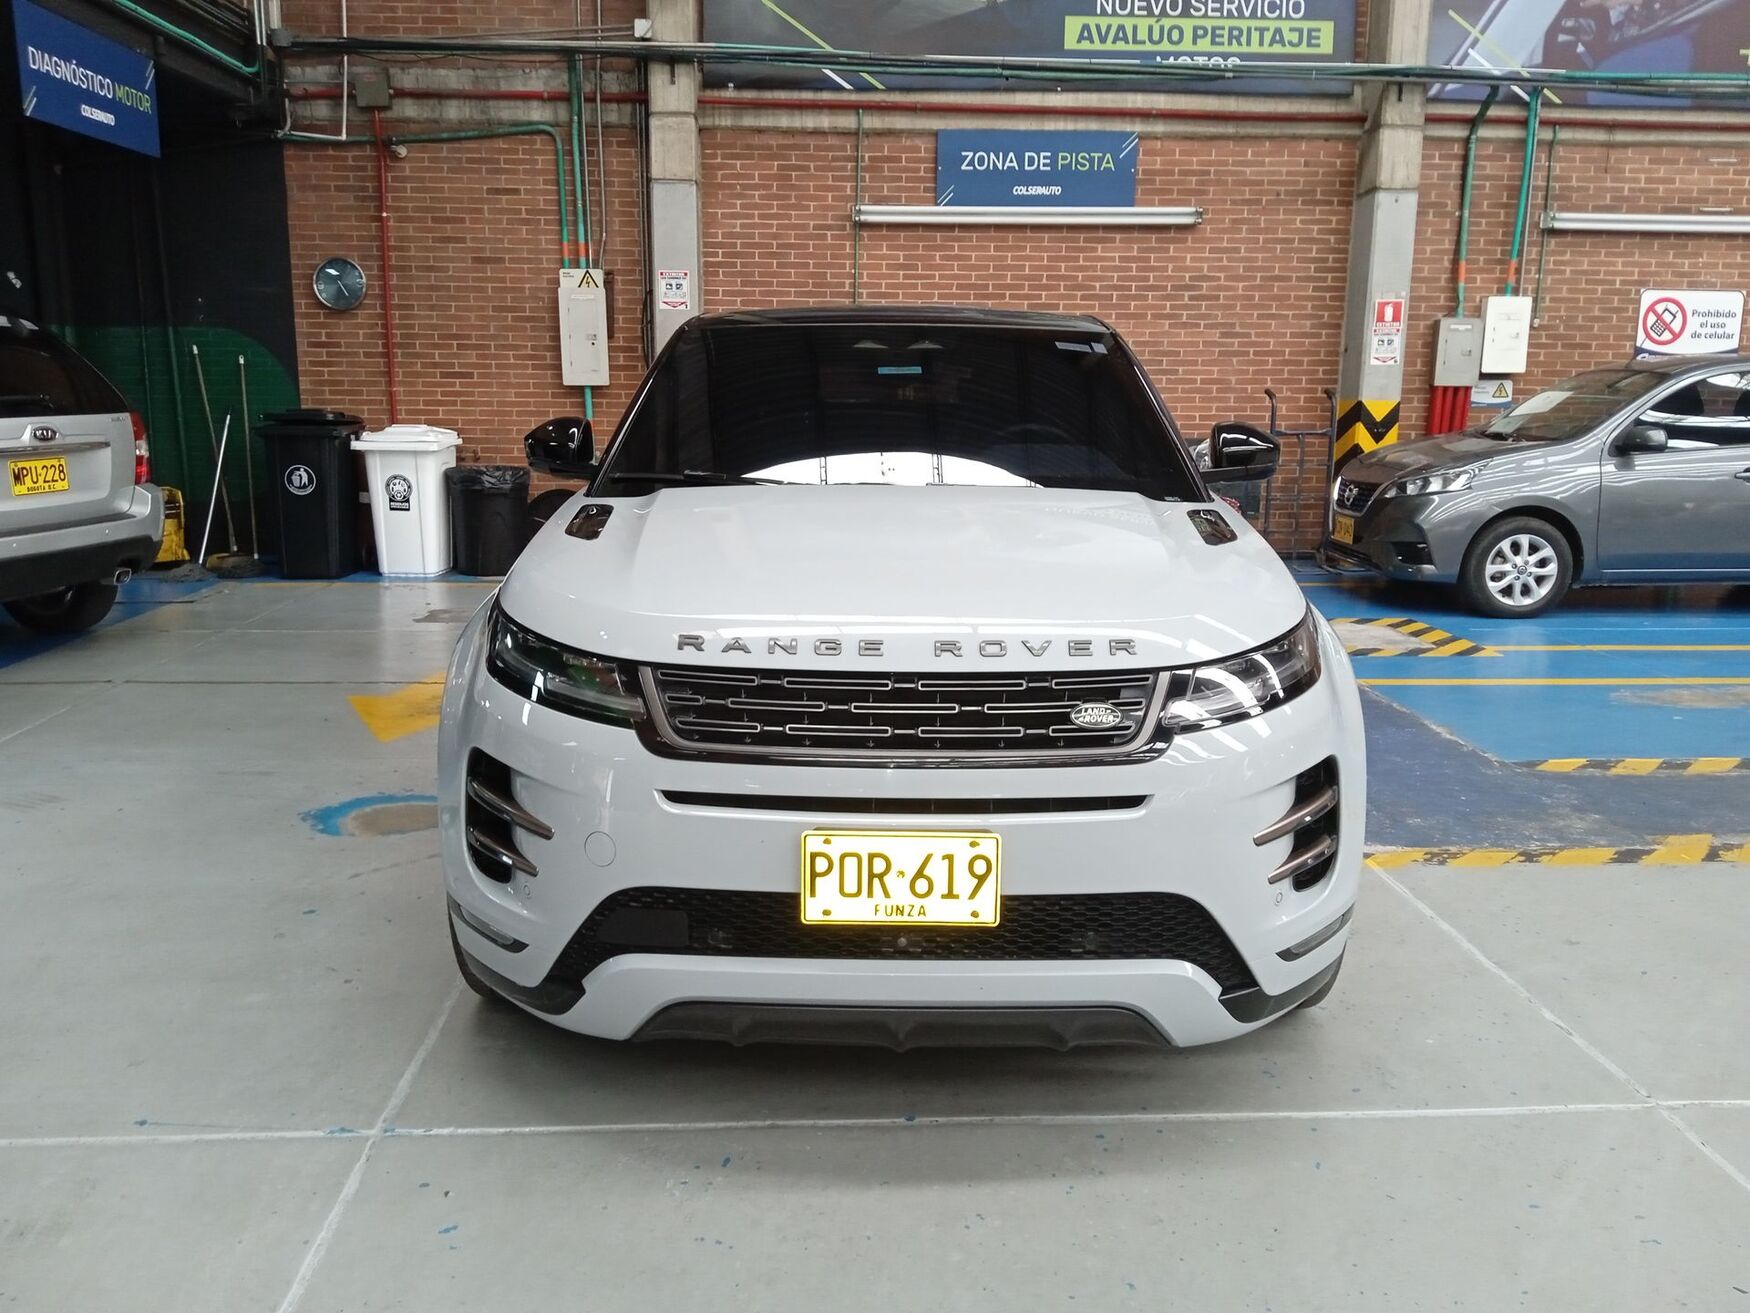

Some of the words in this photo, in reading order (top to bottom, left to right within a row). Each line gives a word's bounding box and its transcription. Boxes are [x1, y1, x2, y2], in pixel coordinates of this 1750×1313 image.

[1096, 0, 1182, 16] NUEVO
[1190, 0, 1305, 19] SERVICIO
[1077, 19, 1184, 46] AVALÚO
[1191, 25, 1321, 48] PERITAJE
[28, 46, 113, 99] DIAGNÓSTICO
[115, 82, 152, 114] MOTOR
[960, 151, 1019, 171] ZONA
[1024, 151, 1051, 171] DE
[1058, 152, 1116, 172] PISTA
[1012, 185, 1062, 196] COLSERAUTO
[1691, 309, 1737, 318] Prohibido
[1699, 320, 1708, 329] el
[1710, 321, 1726, 329] uso
[1690, 330, 1702, 339] de
[1704, 331, 1735, 339] celular
[677, 634, 884, 657] RANGE
[934, 638, 1138, 659] ROVER
[1081, 707, 1106, 715] LAND
[1083, 714, 1114, 723] ROVER
[874, 904, 927, 917] FUNZA
